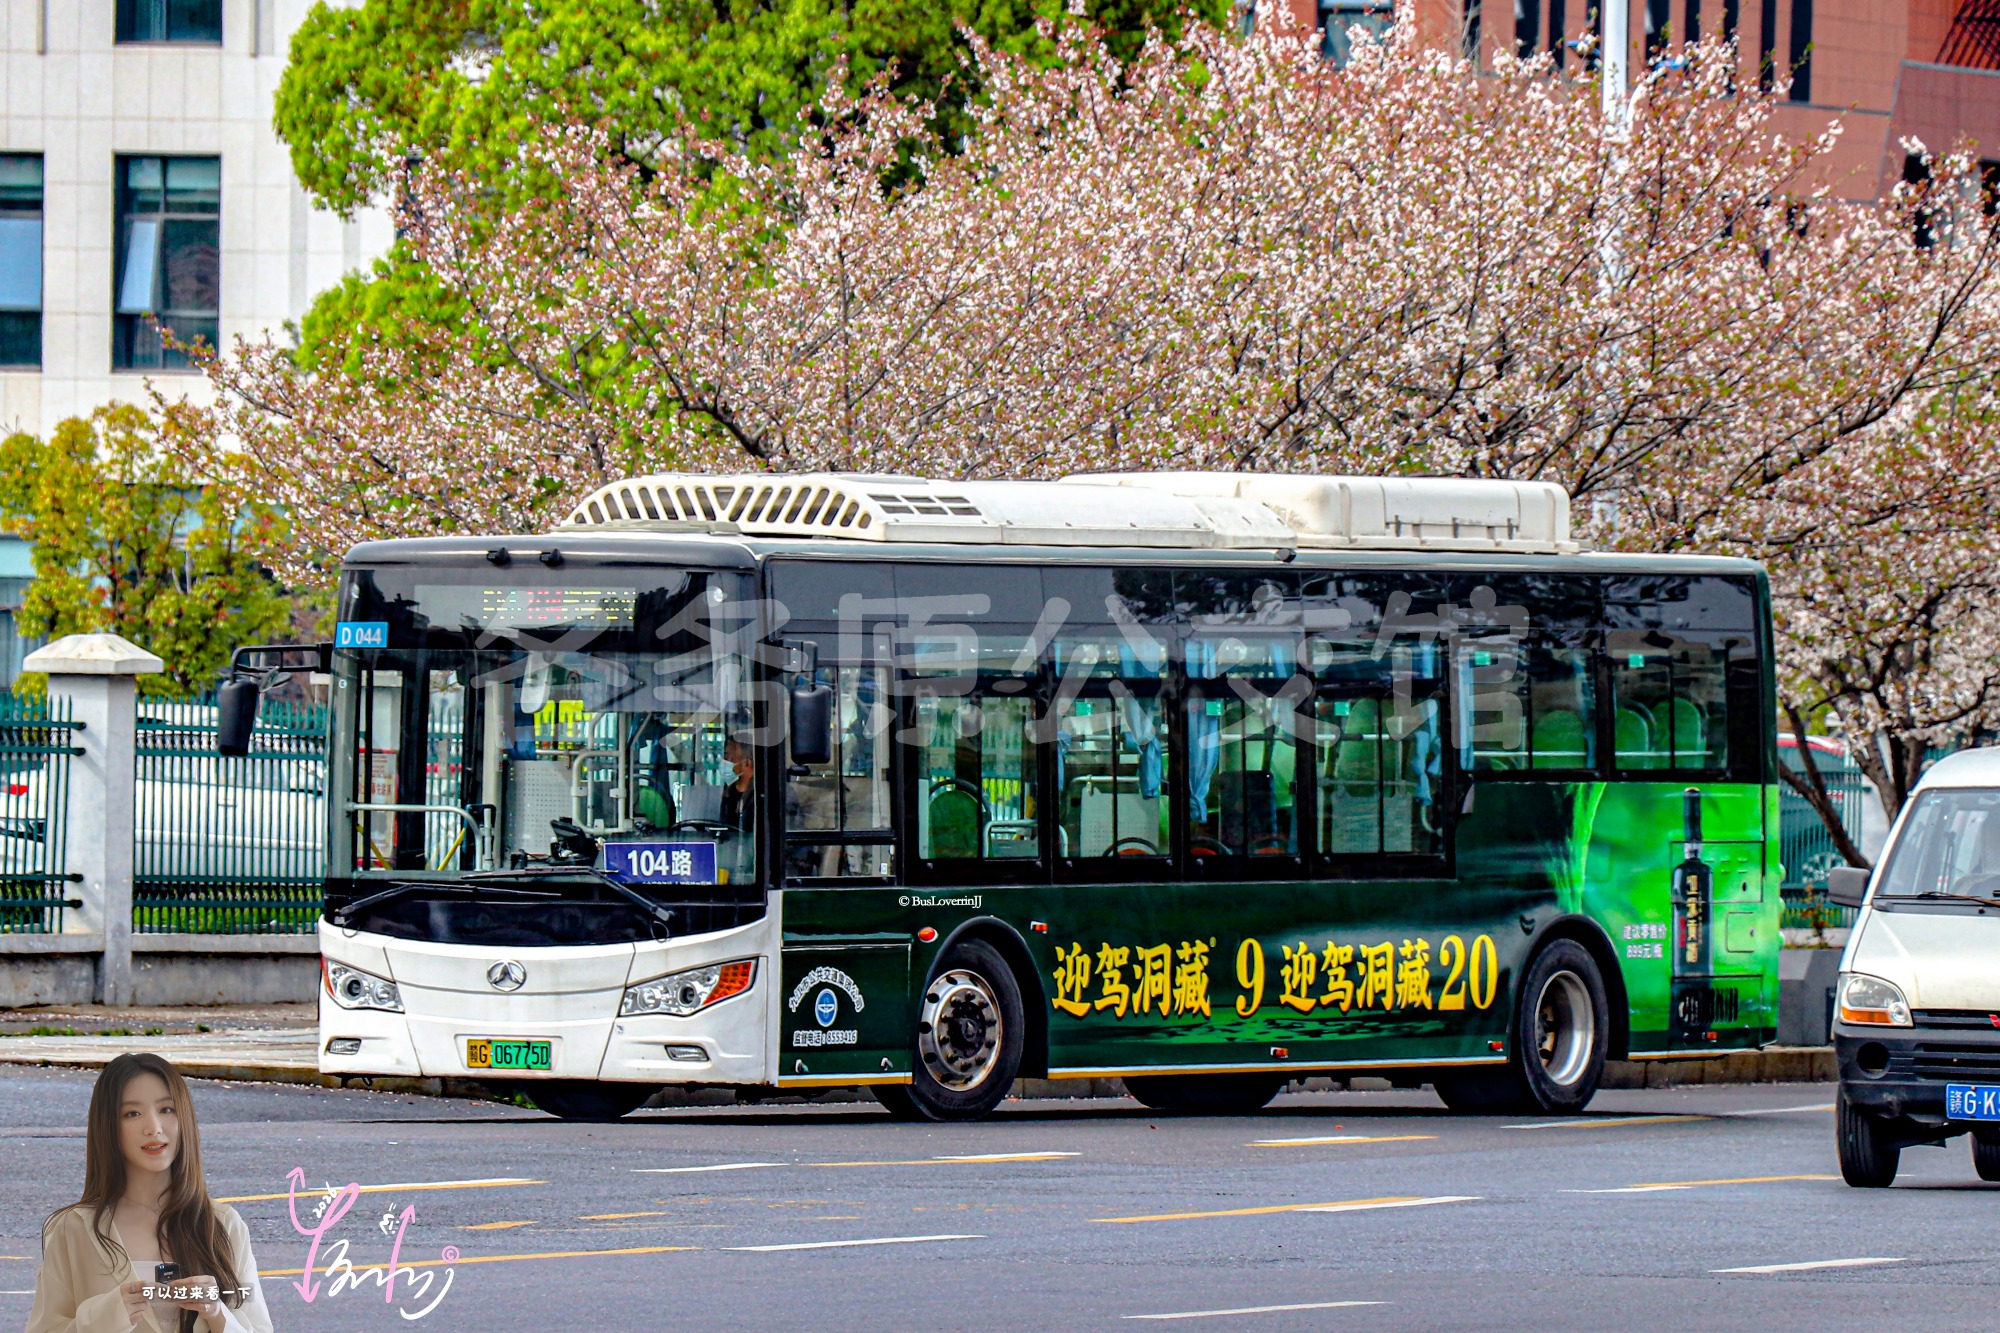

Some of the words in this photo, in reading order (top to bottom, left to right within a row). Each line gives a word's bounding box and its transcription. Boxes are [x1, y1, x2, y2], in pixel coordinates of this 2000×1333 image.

[342, 627, 351, 644] D
[355, 627, 382, 644] 044
[627, 850, 692, 876] 104路
[1052, 941, 1211, 1017] 迎驾洞藏
[1236, 938, 1265, 1016] 9
